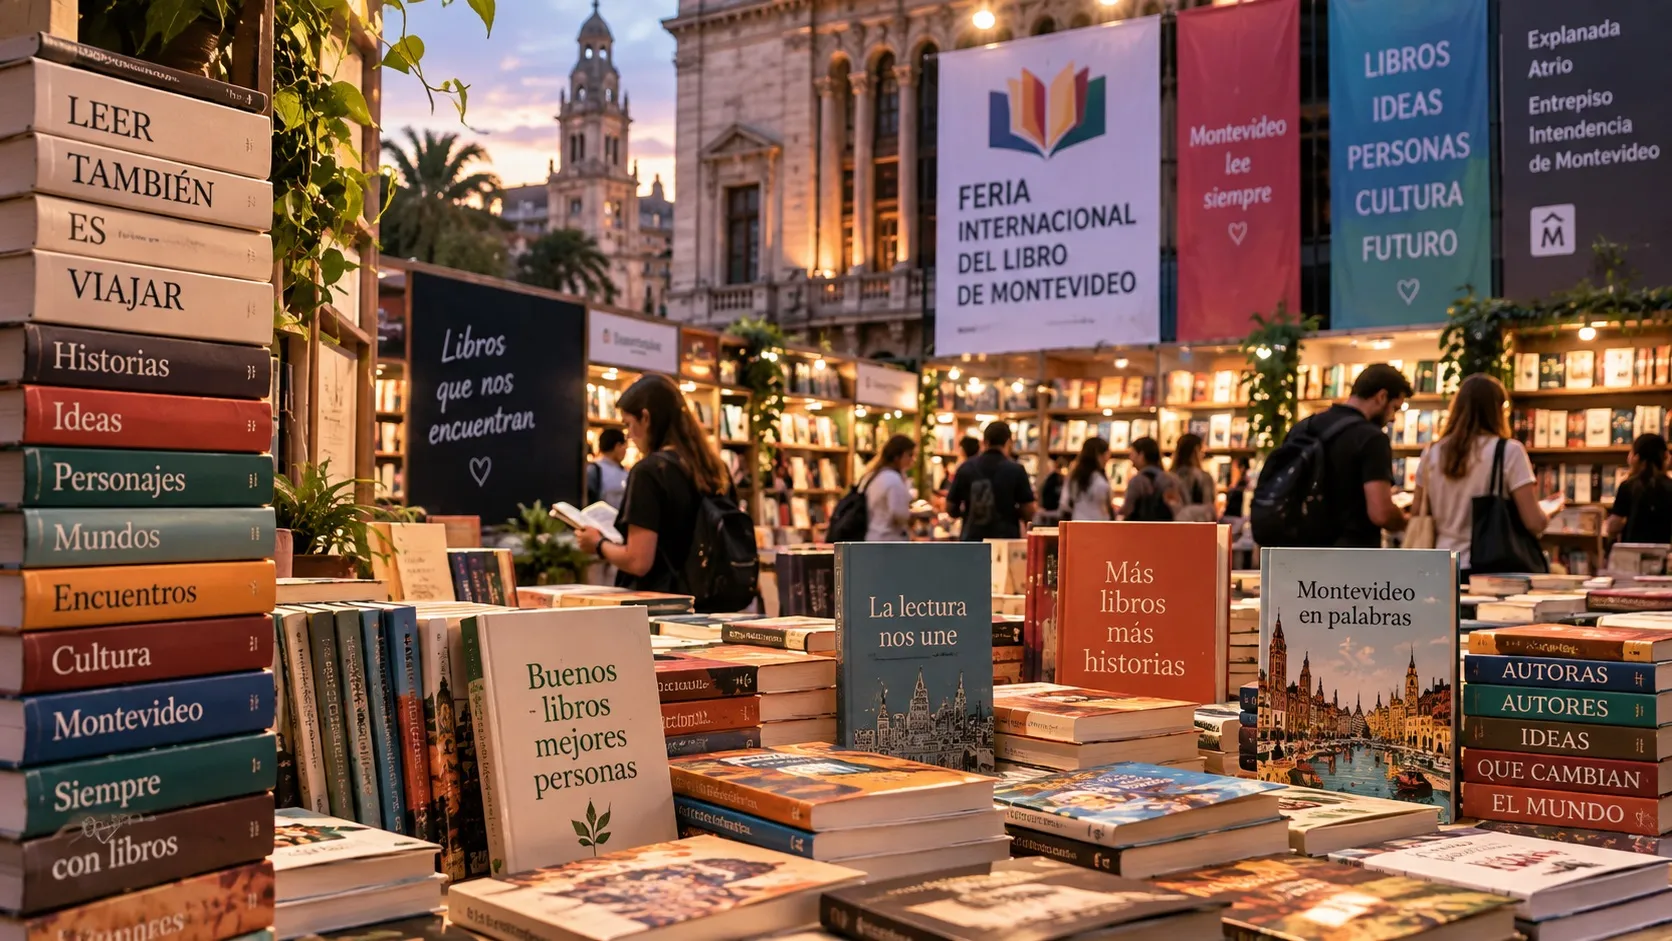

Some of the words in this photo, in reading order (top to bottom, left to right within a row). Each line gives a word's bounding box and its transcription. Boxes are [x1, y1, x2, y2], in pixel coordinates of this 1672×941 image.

[1527, 19, 1621, 50] Explanada
[1364, 40, 1450, 79] LIBROS
[1528, 57, 1573, 79] Atrio
[1373, 88, 1443, 122] IDEAS
[1528, 88, 1613, 115] Entrepiso
[68, 95, 154, 142] LEER
[1189, 115, 1287, 147] Montevideo
[1529, 116, 1633, 144] Intendencia
[1225, 152, 1251, 175] lee
[1347, 132, 1471, 171] PERSONAS
[1529, 154, 1551, 173] de
[1555, 143, 1660, 170] Montevideo
[67, 152, 215, 208] TAMBIÉN
[958, 178, 1031, 210] FERIA
[1203, 185, 1272, 211] siempre
[1355, 181, 1464, 216] CULTURA
[67, 211, 106, 245] ES
[958, 202, 1137, 242] INTERNACIONAL
[958, 250, 997, 274] DEL
[1003, 243, 1068, 270] LIBRO
[1362, 229, 1458, 262] FUTURO
[67, 268, 185, 311] VIAJAR
[957, 283, 986, 306] DE
[990, 270, 1137, 304] MONTEVIDEO
[441, 324, 507, 363] Libros
[53, 341, 170, 378] Historias
[436, 379, 473, 413] que
[480, 372, 515, 395] nos
[53, 402, 122, 432] Ideas
[428, 406, 536, 445] encuentran
[53, 462, 186, 498] Personajes
[53, 522, 160, 551] Mundos
[1105, 561, 1154, 584] Más
[53, 584, 197, 612] Encuentros
[869, 596, 894, 618] La
[899, 595, 967, 618] lectura
[1099, 589, 1166, 615] libros
[1297, 580, 1416, 602] Montevideo
[1106, 621, 1154, 644] más
[1299, 609, 1323, 625] en
[1329, 605, 1412, 629] palabras
[879, 630, 914, 648] nos
[921, 628, 958, 646] une
[52, 642, 152, 675] Cultura
[1083, 648, 1185, 676] historias
[1502, 662, 1608, 684] AUTORAS
[526, 662, 618, 690] Buenos
[52, 696, 204, 742] Montevideo
[543, 695, 611, 723] libros
[1501, 694, 1609, 718] AUTORES
[535, 727, 627, 761] mejores
[1520, 727, 1590, 750] IDEAS
[534, 760, 638, 800] personas
[1477, 758, 1525, 782] QUE
[1531, 762, 1641, 790] CAMBIAN
[54, 773, 161, 812] Siempre
[1492, 793, 1520, 814] EL
[1525, 797, 1625, 824] MUNDO
[52, 852, 101, 881] con
[108, 835, 179, 870] libros
